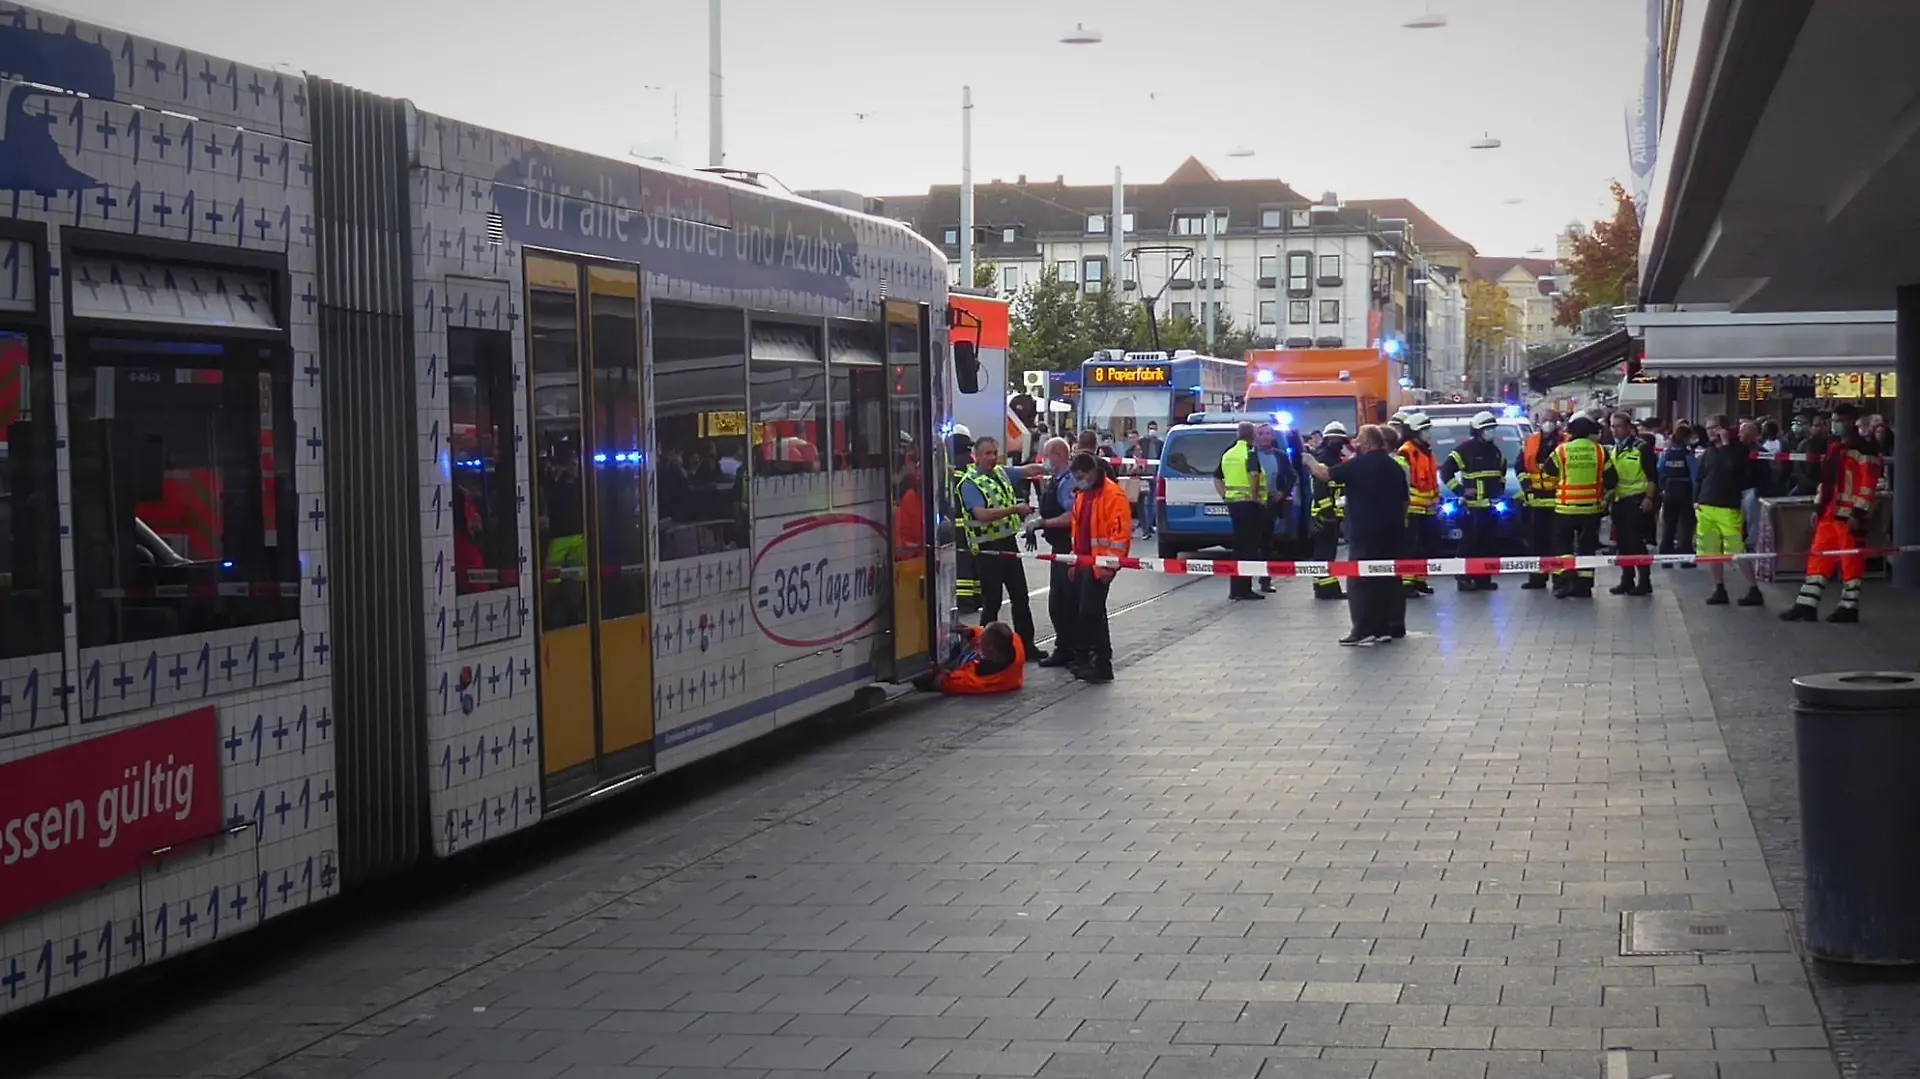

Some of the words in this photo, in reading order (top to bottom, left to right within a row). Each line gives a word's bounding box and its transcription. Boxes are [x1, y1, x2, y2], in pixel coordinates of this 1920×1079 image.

[523, 157, 571, 232] für
[580, 174, 631, 243] alle
[641, 185, 729, 258] Schüler
[735, 211, 775, 266] und
[781, 219, 842, 277] Azubis
[1095, 368, 1104, 382] 8
[1108, 367, 1165, 382] Papierfabrik
[815, 557, 850, 618] Tage
[97, 753, 194, 848] gültig
